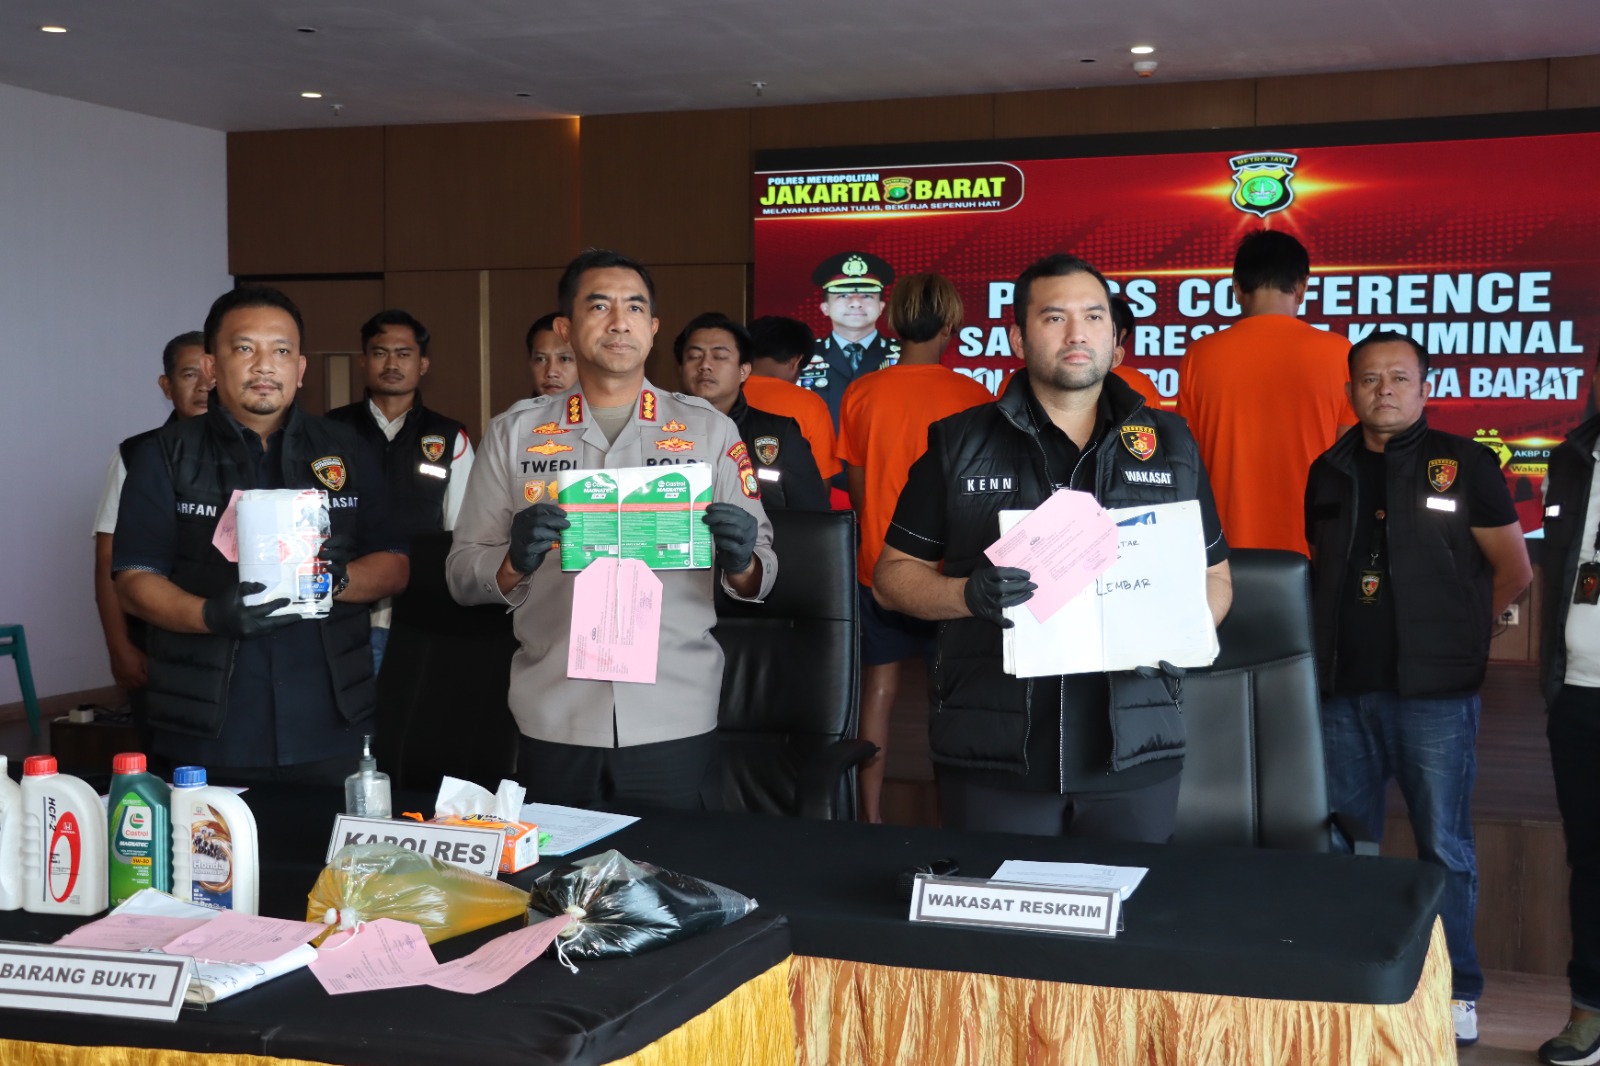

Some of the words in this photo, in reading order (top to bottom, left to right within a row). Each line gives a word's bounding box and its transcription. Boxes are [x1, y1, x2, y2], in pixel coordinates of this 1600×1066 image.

[768, 176, 805, 186] POLRES
[807, 174, 879, 184] METROPOLITAN
[760, 182, 881, 206] JAKARTA
[915, 177, 1006, 200] BARAT
[762, 207, 808, 215] MELAYANI
[850, 204, 883, 212] TULUS,
[884, 203, 929, 211] BEKERJA
[930, 201, 977, 209] SEPENUH
[978, 200, 1000, 208] HATI
[1178, 271, 1552, 318] COFERENCE
[1469, 367, 1584, 400] BARAT
[1514, 449, 1541, 458] AKBP
[967, 478, 1012, 491] KENN
[1125, 470, 1172, 485] WAKASAT
[329, 496, 358, 508] ASAT
[1095, 578, 1151, 596] LEMBAR
[48, 797, 57, 831] HCF-2
[125, 829, 149, 837] Castrol
[928, 893, 1015, 912] WAKASAT
[1019, 901, 1102, 918] RESKRIM
[0, 963, 86, 984] BARANG
[91, 970, 157, 990] BUKTI
